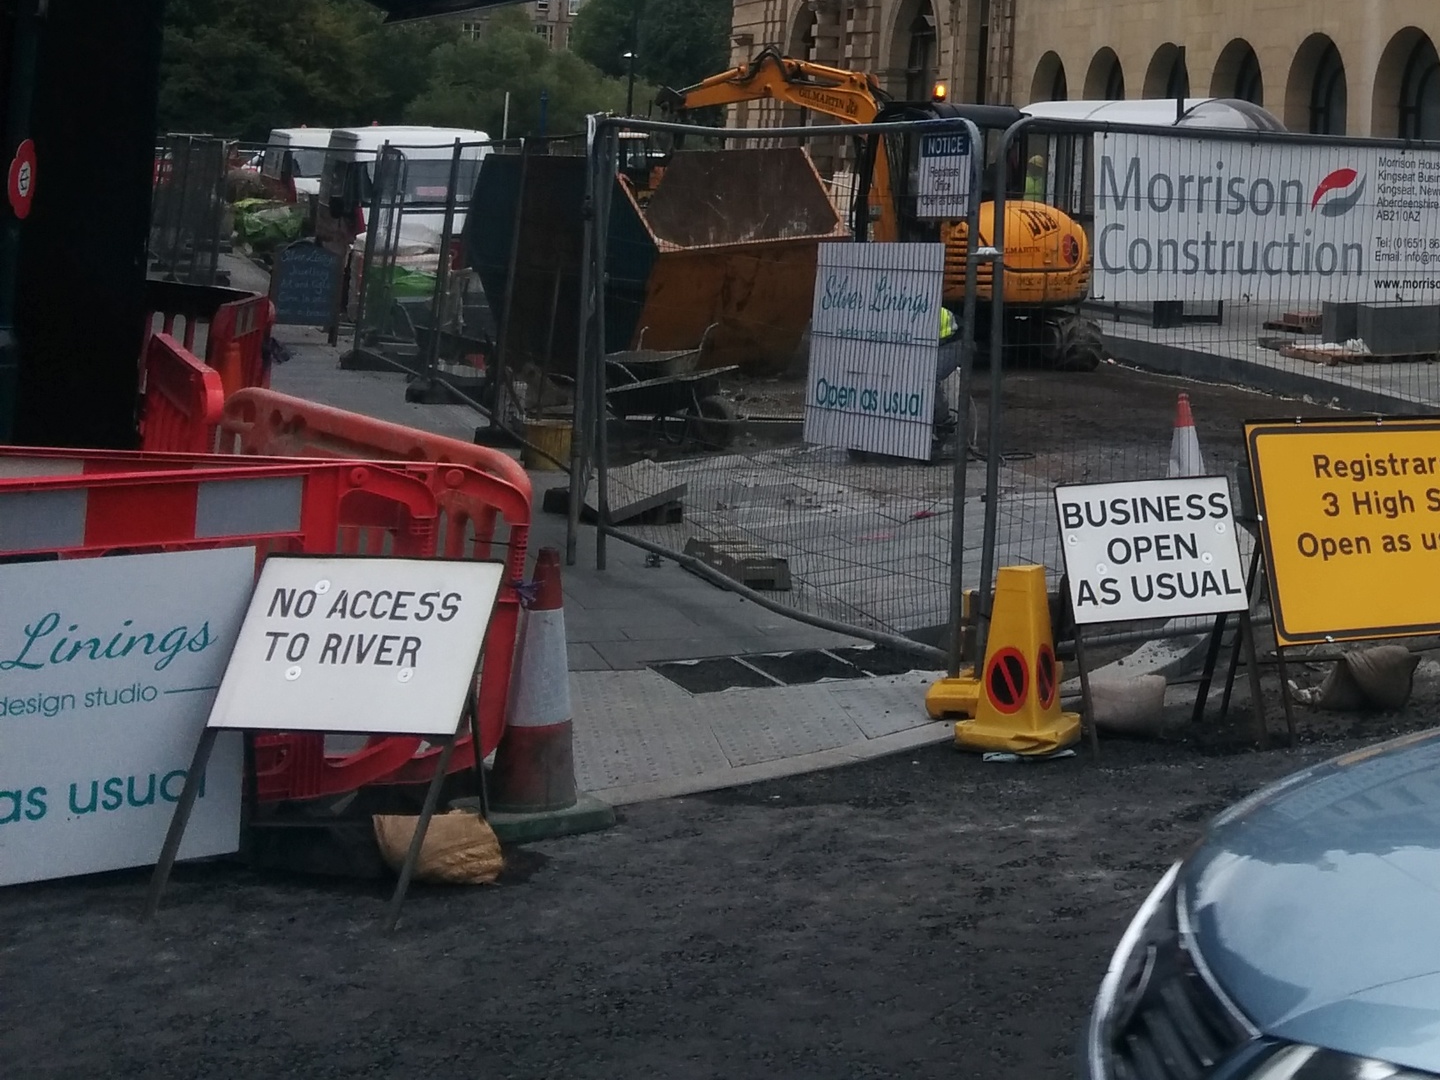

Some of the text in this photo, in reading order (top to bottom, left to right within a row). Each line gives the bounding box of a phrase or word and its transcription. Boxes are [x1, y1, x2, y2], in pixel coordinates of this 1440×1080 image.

[928, 136, 964, 155] NOTICE
[1377, 171, 1416, 184] Kingseat
[1378, 157, 1416, 169] Morrison
[1100, 155, 1303, 217] Morrison
[1377, 184, 1417, 197] Kingseat,
[1376, 197, 1439, 209] Aberdeenshire
[1376, 210, 1400, 221] AB21
[1018, 209, 1059, 237] JCB
[1005, 246, 1041, 254] LMARTIN
[1099, 222, 1363, 276] Construction
[1375, 237, 1391, 248] Tel:
[1393, 237, 1427, 250] (01651)
[1375, 251, 1402, 262] Email:
[822, 275, 930, 322] Silver Linings
[816, 378, 923, 416] Open as usual
[1062, 492, 1229, 529] BUSINESS
[1321, 491, 1341, 517] 3
[1352, 490, 1416, 519] High
[1107, 533, 1199, 565] OPEN
[1297, 532, 1371, 561] Open
[1381, 532, 1412, 553] as
[1077, 569, 1242, 607] AS USUAL
[267, 588, 462, 622] NO ACCESS
[0, 612, 219, 671] Linings
[265, 631, 422, 668] TO RIVER
[84, 682, 158, 709] studio
[0, 786, 47, 825] as
